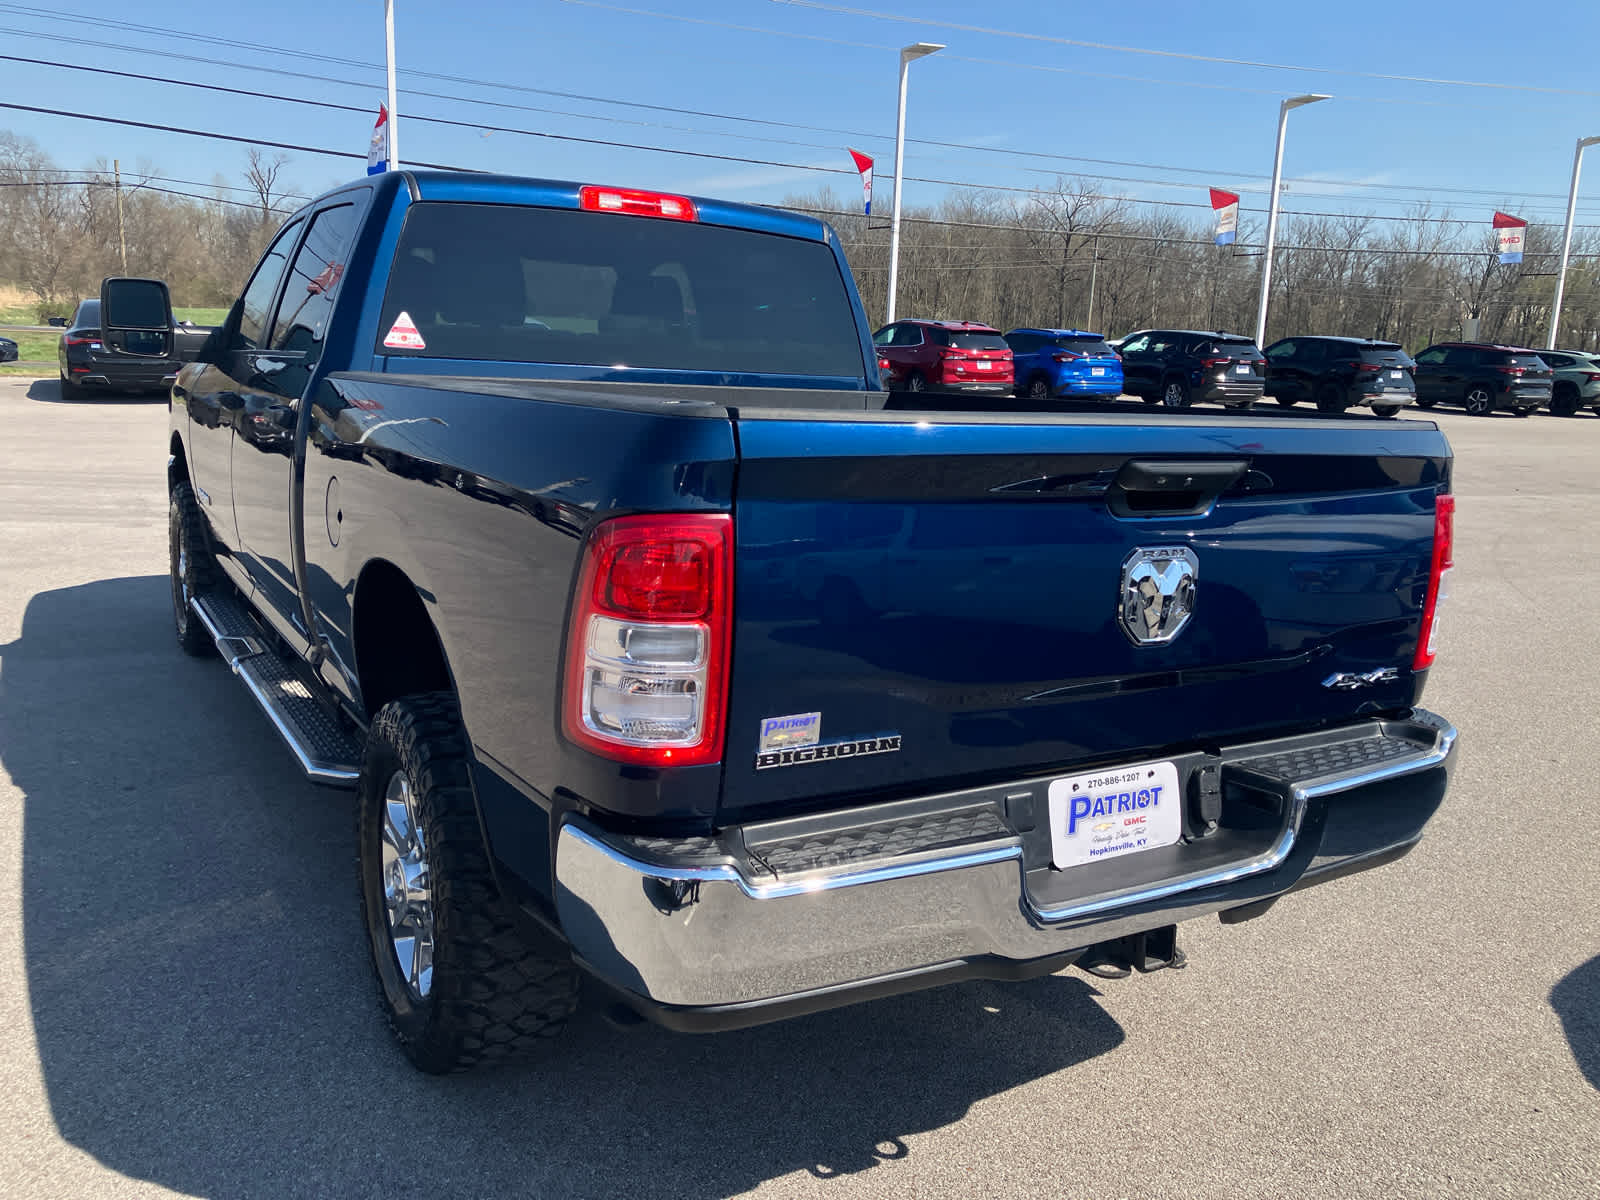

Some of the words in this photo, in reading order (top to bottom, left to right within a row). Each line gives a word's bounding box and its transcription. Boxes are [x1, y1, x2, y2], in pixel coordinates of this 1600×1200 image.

[1142, 548, 1187, 559] RAM
[763, 714, 818, 737] PATRIOT
[756, 734, 902, 770] BIGHORN
[1087, 772, 1141, 789] 270-886-1207
[1067, 785, 1163, 834] PATRIOT
[1123, 815, 1147, 827] GMC
[1089, 840, 1136, 857] Hopkinsville,
[1136, 838, 1148, 848] KY
